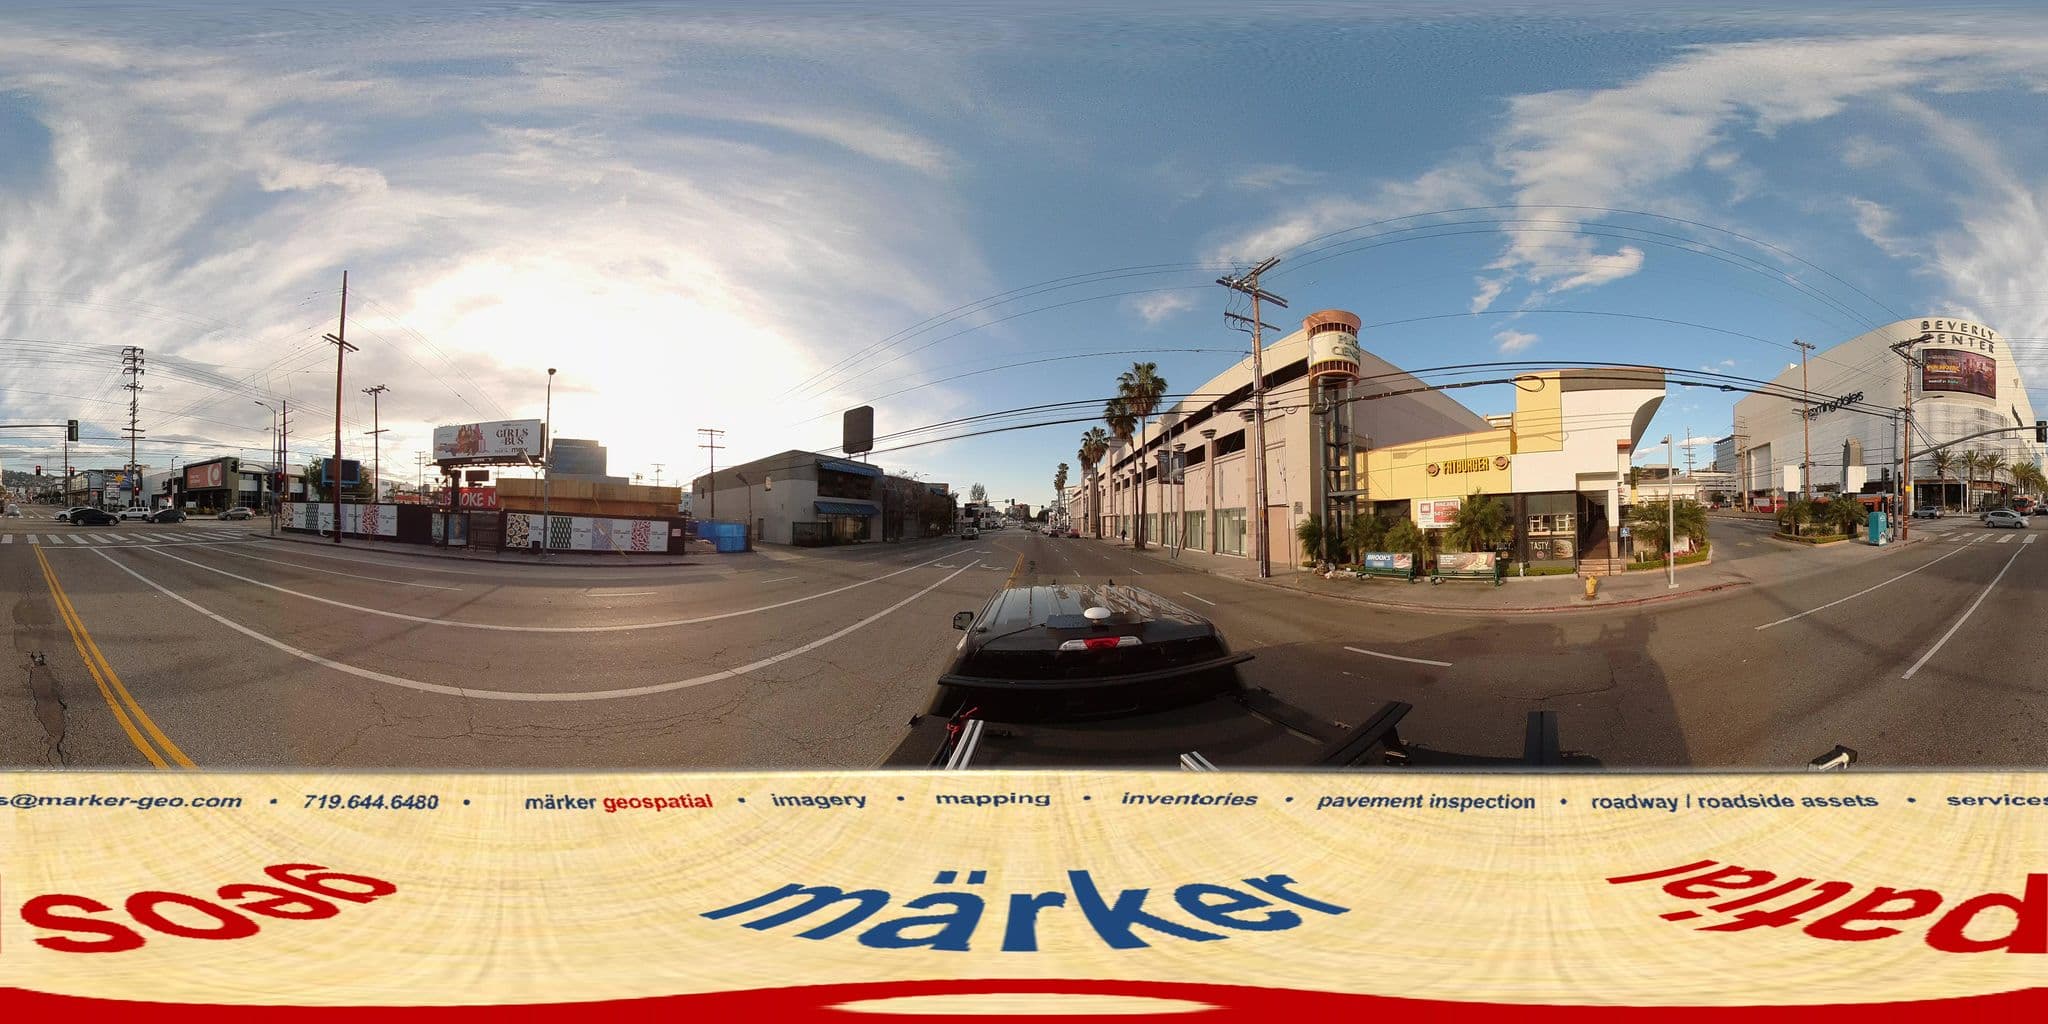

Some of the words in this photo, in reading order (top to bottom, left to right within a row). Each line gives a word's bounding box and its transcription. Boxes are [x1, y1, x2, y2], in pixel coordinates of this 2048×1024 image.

[1921, 320, 1994, 340] BEVERLY
[495, 428, 529, 438] GIRLS
[504, 436, 524, 446] BUS
[1444, 457, 1490, 475] FATBURGER
